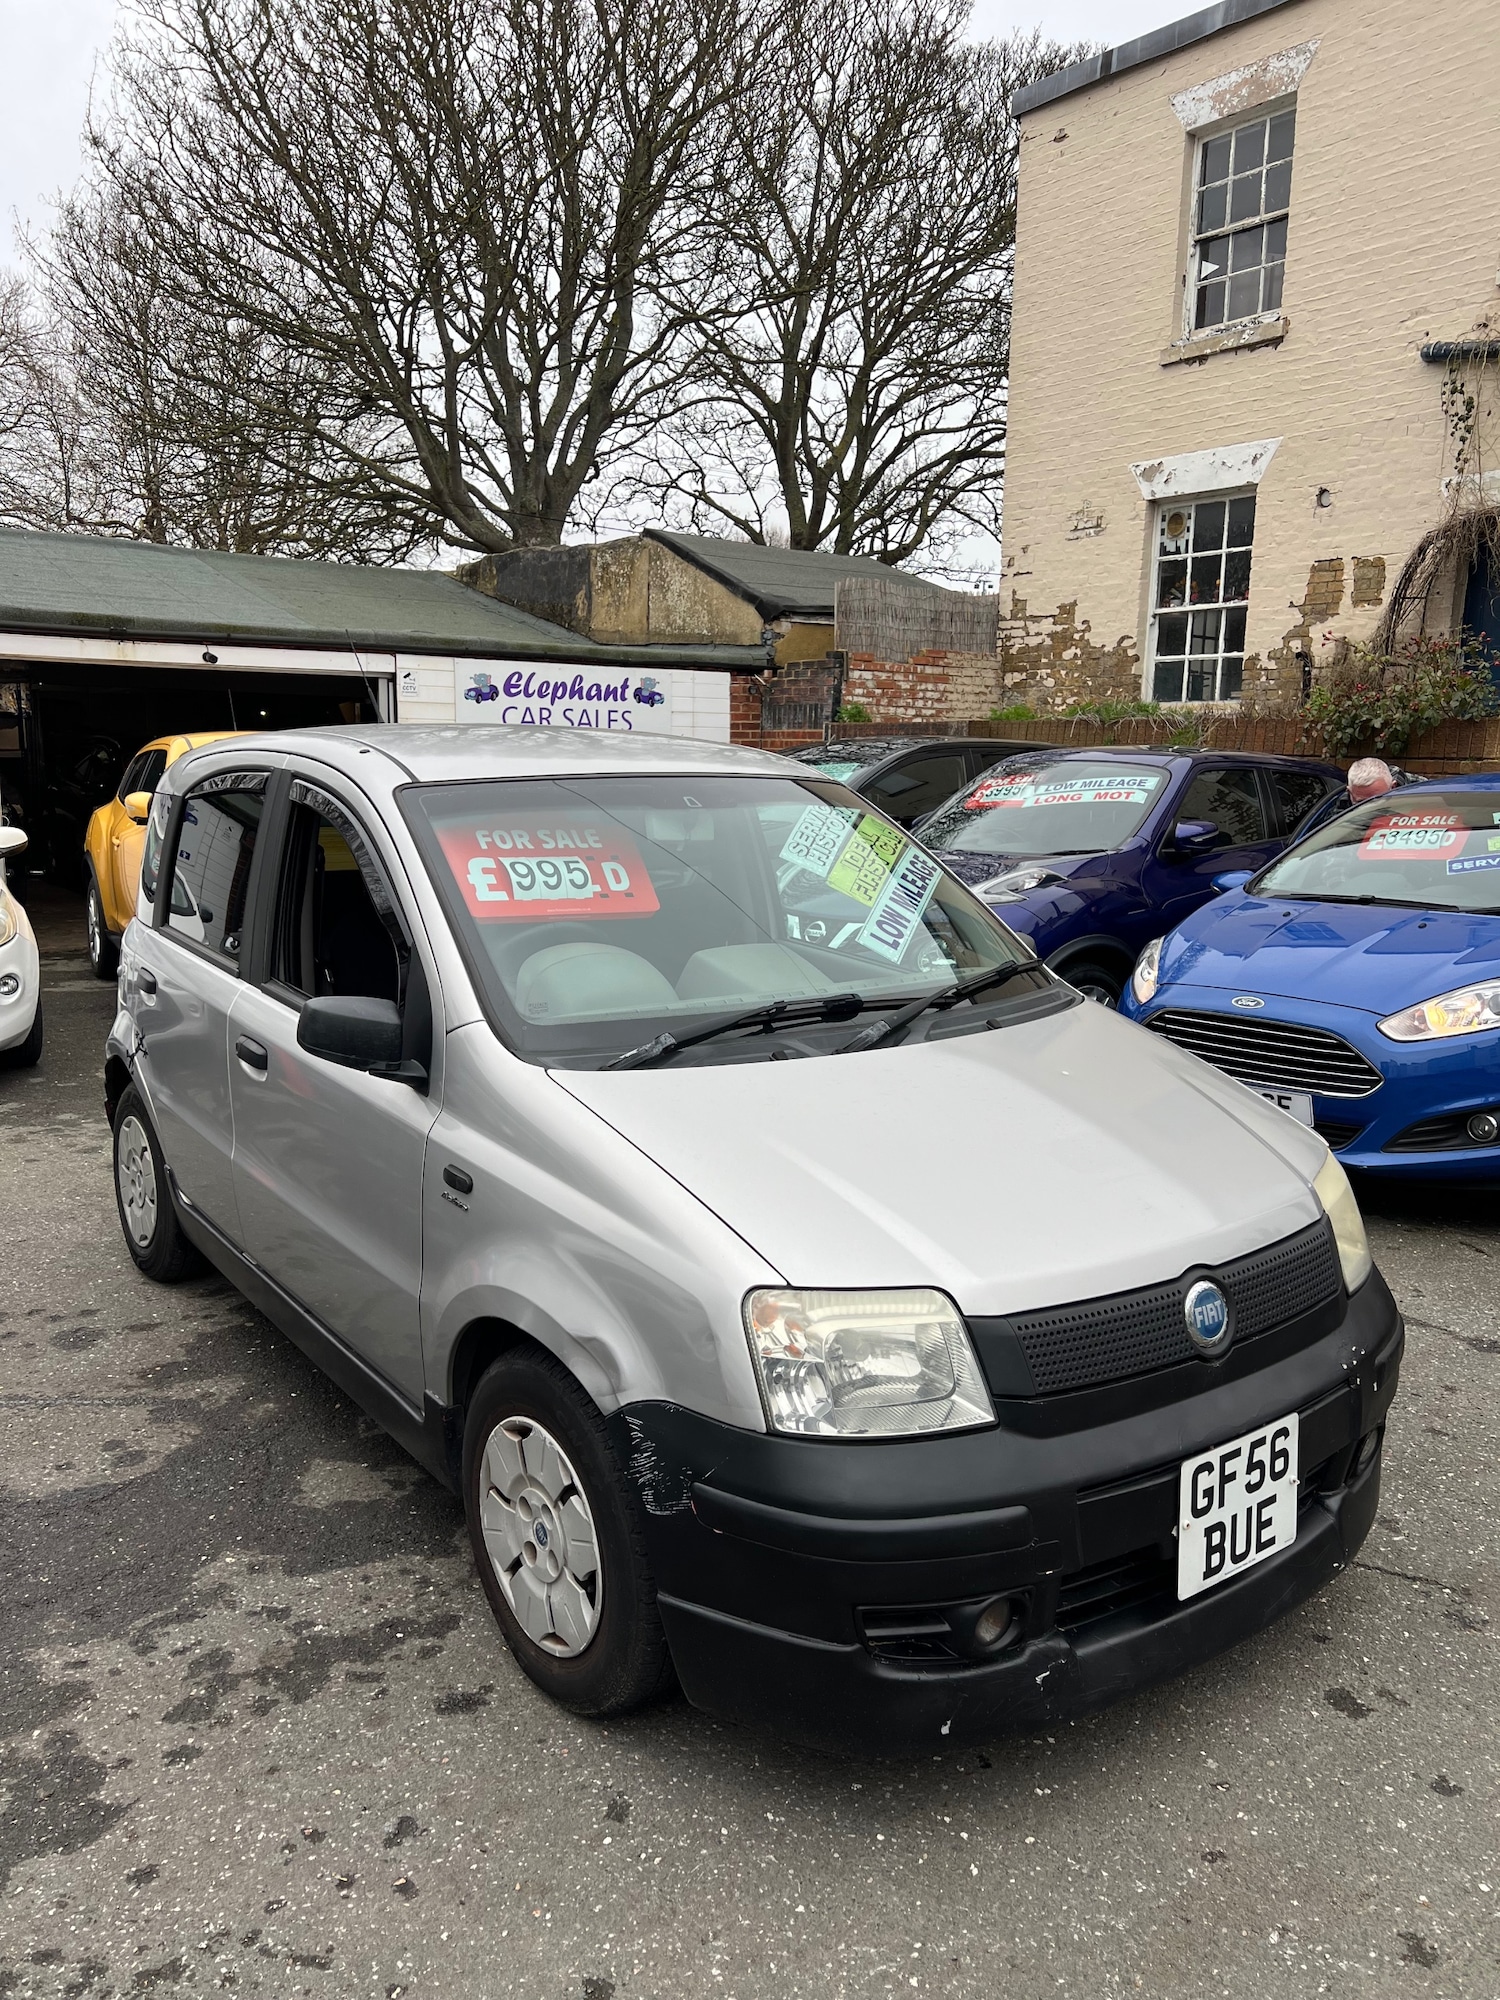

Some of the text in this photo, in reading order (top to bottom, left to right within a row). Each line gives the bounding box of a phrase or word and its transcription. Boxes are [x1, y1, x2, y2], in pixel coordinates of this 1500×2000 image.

[503, 671, 629, 706] Elephant
[501, 706, 552, 725] CAR
[1034, 791, 1136, 805] LONG MOT
[1045, 778, 1149, 792] LOW MILEAGE
[788, 805, 832, 858] SERVIC
[1389, 815, 1459, 826] FOR SALE
[475, 829, 603, 849] FOR SALE
[840, 831, 880, 872] IDEAL
[592, 861, 631, 892] D
[850, 827, 904, 901] FIRST CAR
[869, 853, 938, 951] LOW MILEAGE
[1194, 1300, 1223, 1329] FIAT
[1191, 1427, 1290, 1519] GF56
[1203, 1494, 1277, 1581] BUE
